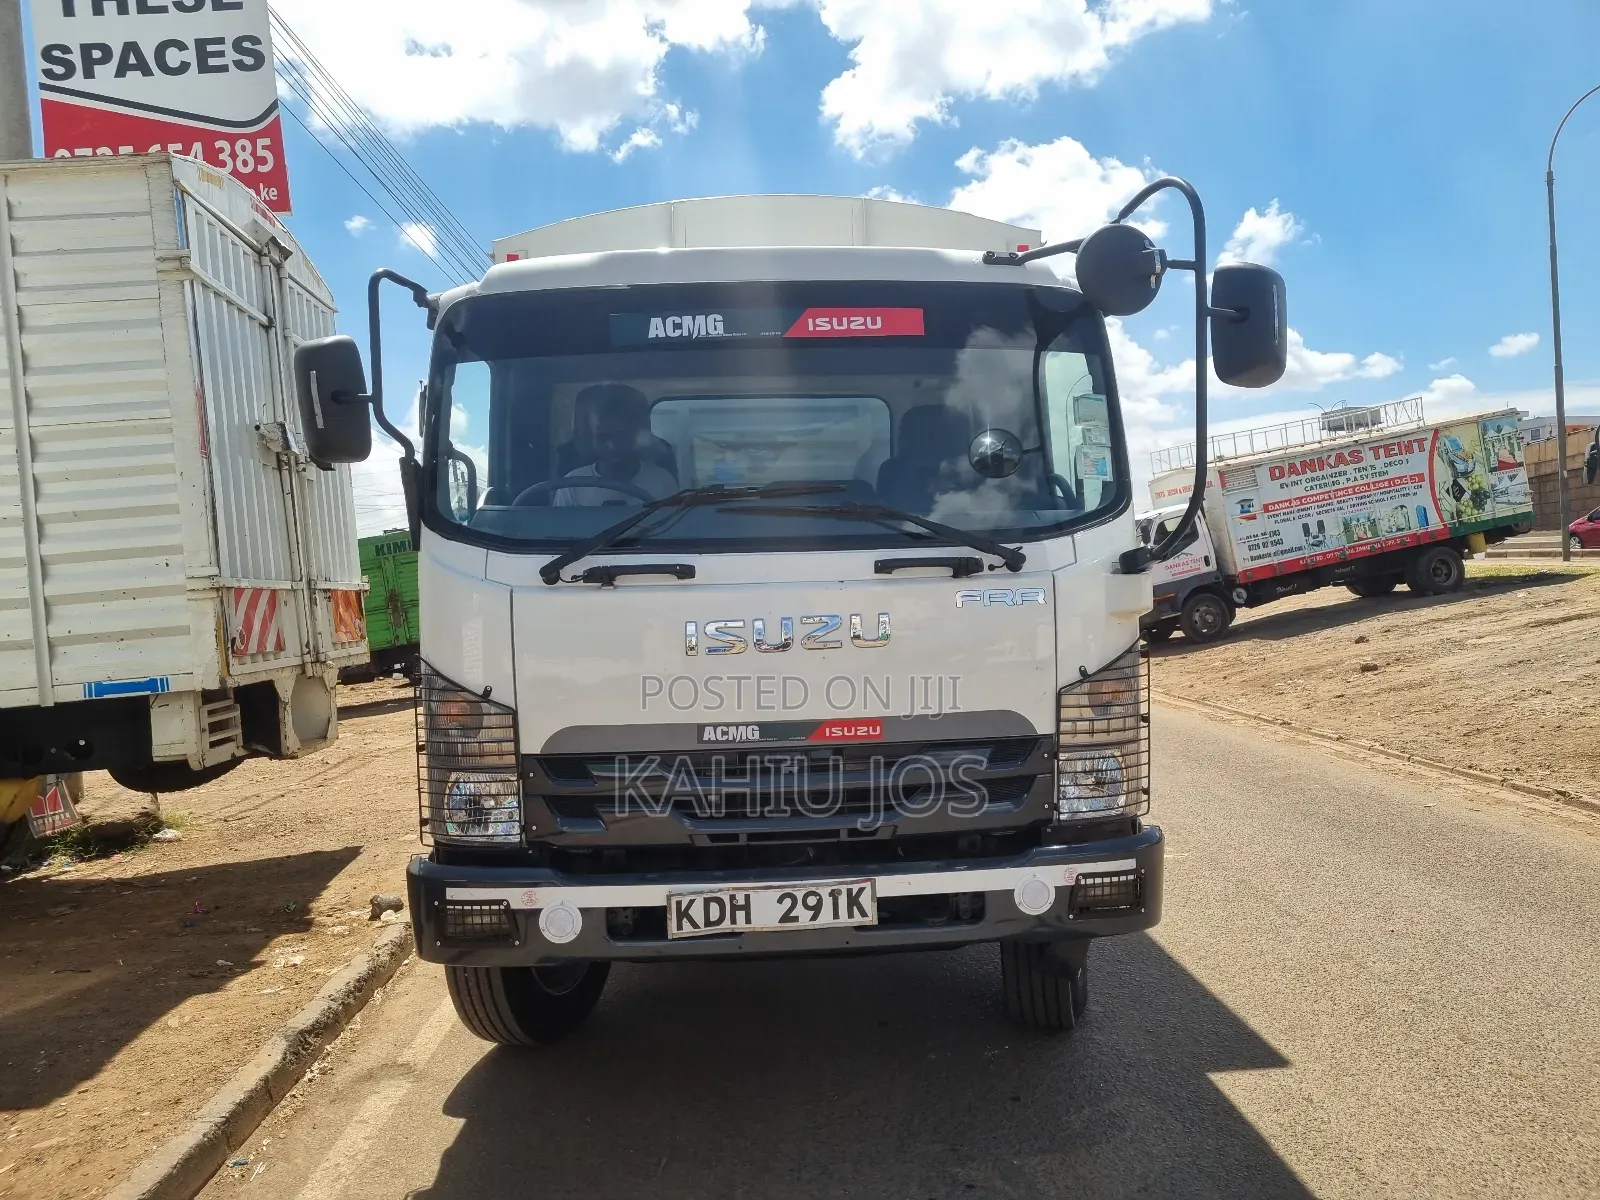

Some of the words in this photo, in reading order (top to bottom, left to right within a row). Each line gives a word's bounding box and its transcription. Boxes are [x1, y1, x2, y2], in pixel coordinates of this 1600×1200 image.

[40, 34, 266, 82] SPACES
[647, 313, 725, 339] ACMG
[808, 315, 883, 332] ISUZU
[1268, 449, 1364, 481] DANKAS
[954, 587, 1048, 608] FRR
[684, 611, 892, 663] ISUZU
[702, 724, 760, 743] ACMG
[825, 725, 881, 738] ISUZU
[675, 893, 752, 931] KDH
[776, 886, 870, 924] 291K
